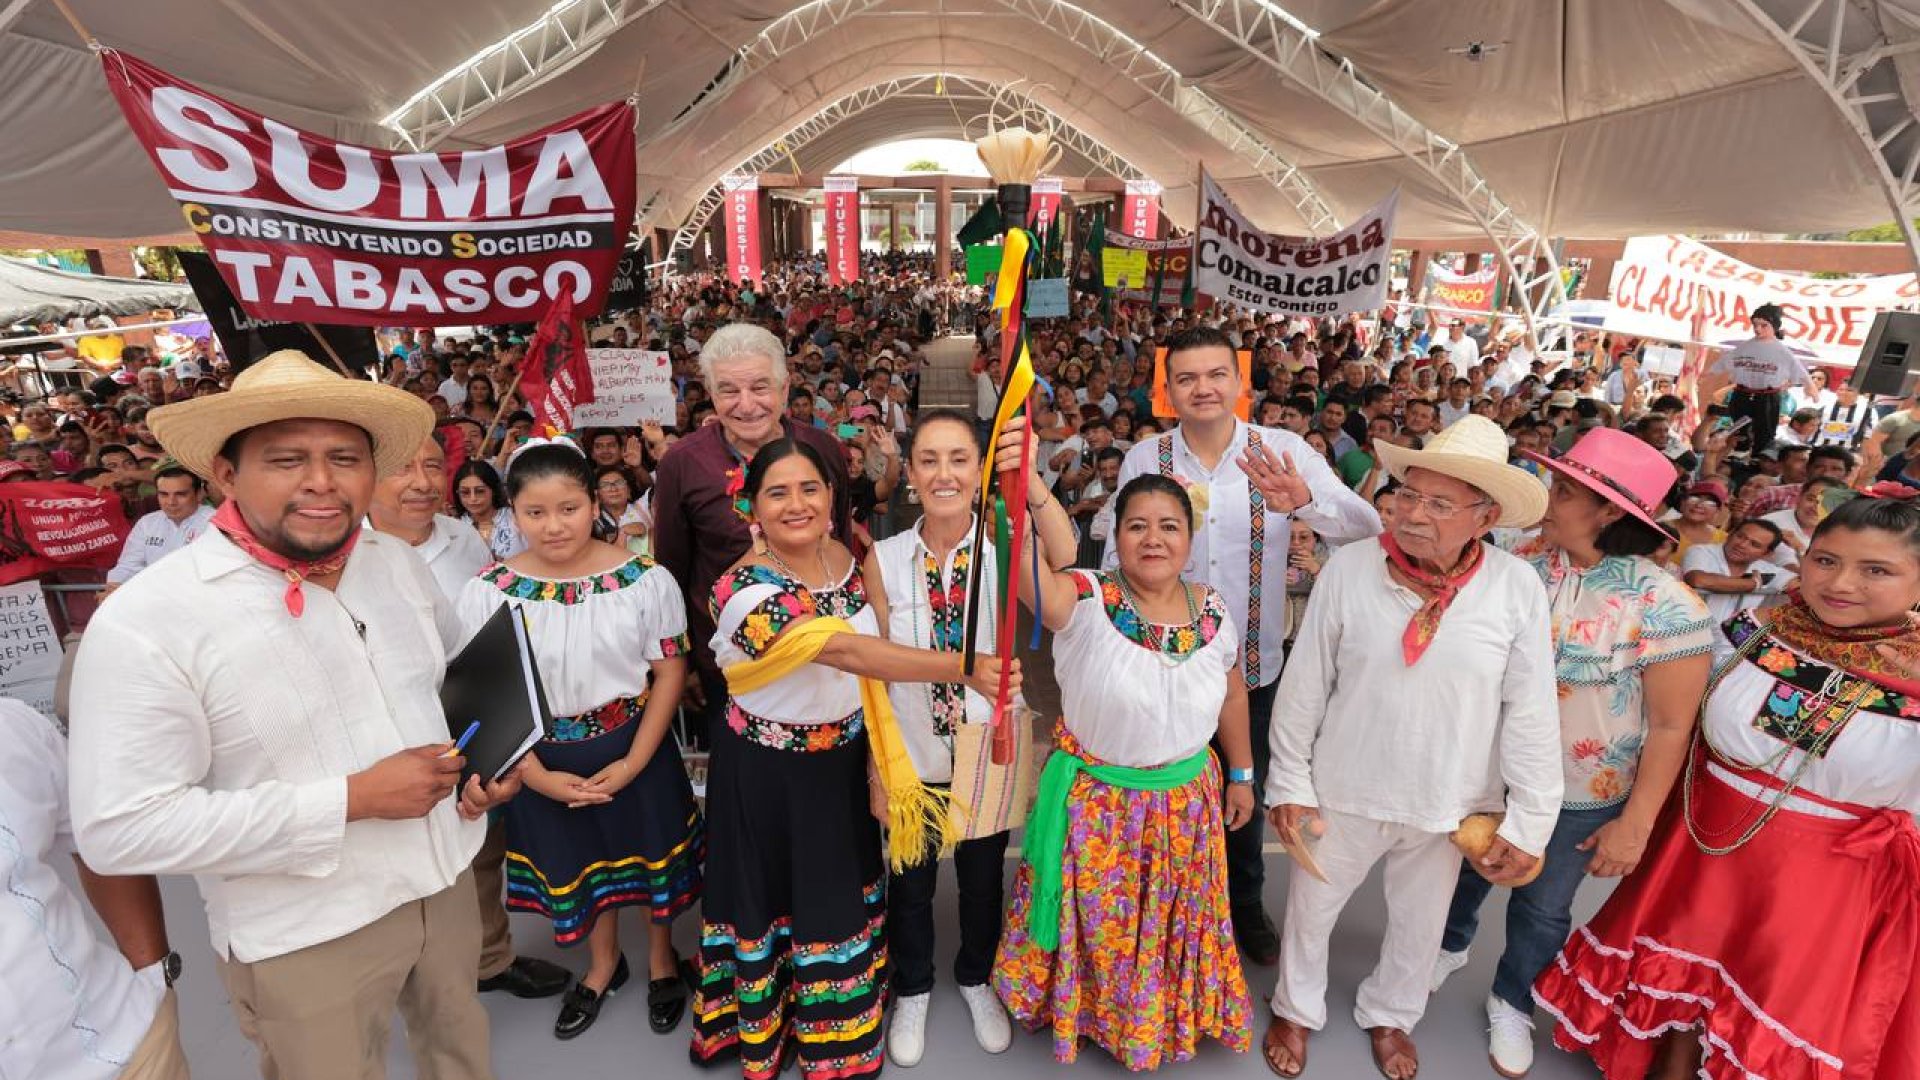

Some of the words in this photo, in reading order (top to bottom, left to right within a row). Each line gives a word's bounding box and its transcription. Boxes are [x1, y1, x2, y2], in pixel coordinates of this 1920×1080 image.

[152, 86, 614, 219] SUMA
[183, 203, 443, 256] CONSTRUYENDO
[452, 230, 592, 259] SOCIEDAD
[1200, 199, 1385, 268] morena
[216, 249, 592, 313] TABASCO
[1200, 239, 1381, 297] Comalcalco
[1615, 265, 1751, 332] CLAUDIA
[1668, 235, 1867, 298] TABASCO
